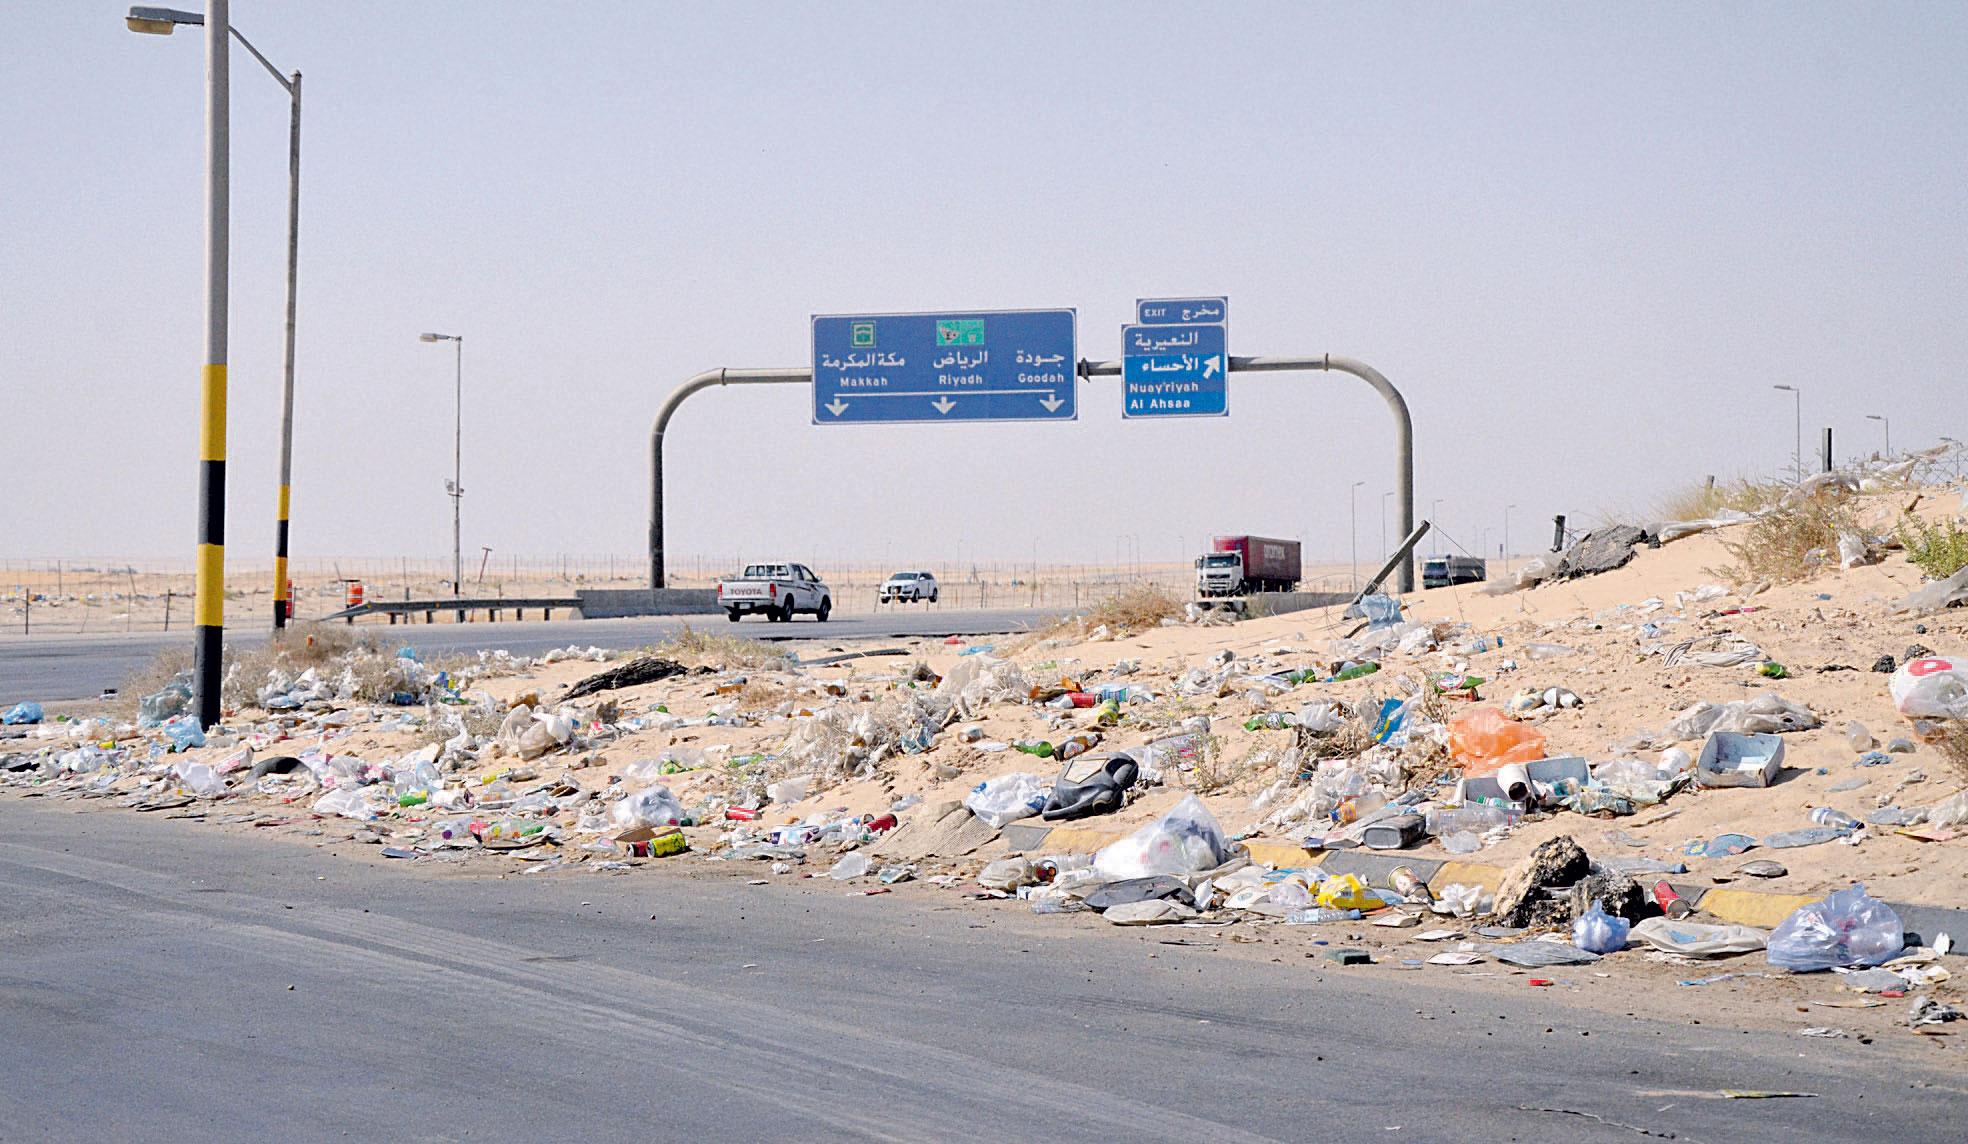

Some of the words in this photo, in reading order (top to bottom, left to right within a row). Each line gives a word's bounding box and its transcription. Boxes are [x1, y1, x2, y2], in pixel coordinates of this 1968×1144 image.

[1144, 308, 1167, 317] EXIT
[1182, 304, 1219, 321] مخرج
[1135, 331, 1198, 351] النعيرية
[822, 352, 876, 371] المكرمة
[877, 350, 906, 367] مكة
[933, 350, 989, 369] الرياض
[1015, 349, 1065, 368] جودة
[1142, 353, 1198, 372] الأحساء
[840, 375, 888, 388] Makkah
[939, 374, 983, 387] Riyadh
[1017, 372, 1065, 384] Goodah
[1129, 381, 1199, 395] Nuay'riyah
[1130, 399, 1144, 409] Al
[1149, 398, 1191, 409] Ahsaa
[729, 587, 763, 596] TOYOTA
